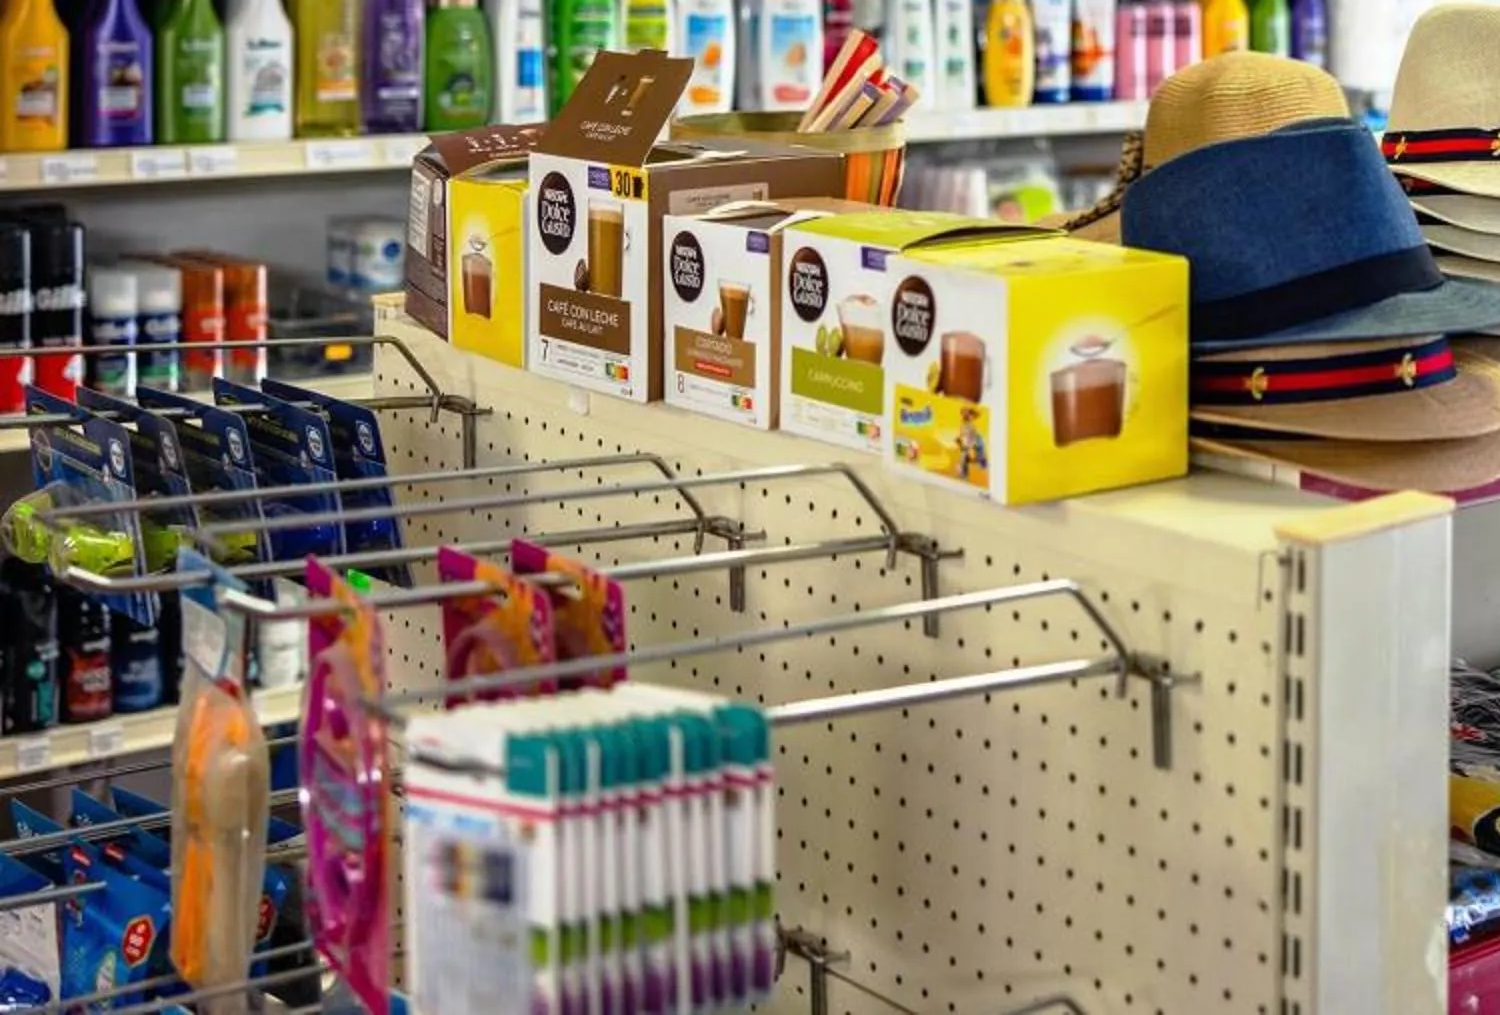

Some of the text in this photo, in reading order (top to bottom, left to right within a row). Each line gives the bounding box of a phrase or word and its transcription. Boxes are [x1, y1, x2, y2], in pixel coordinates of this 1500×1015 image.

[615, 171, 631, 197] 30
[569, 304, 589, 320] CON
[590, 310, 619, 327] LECHE
[541, 338, 549, 361] 7
